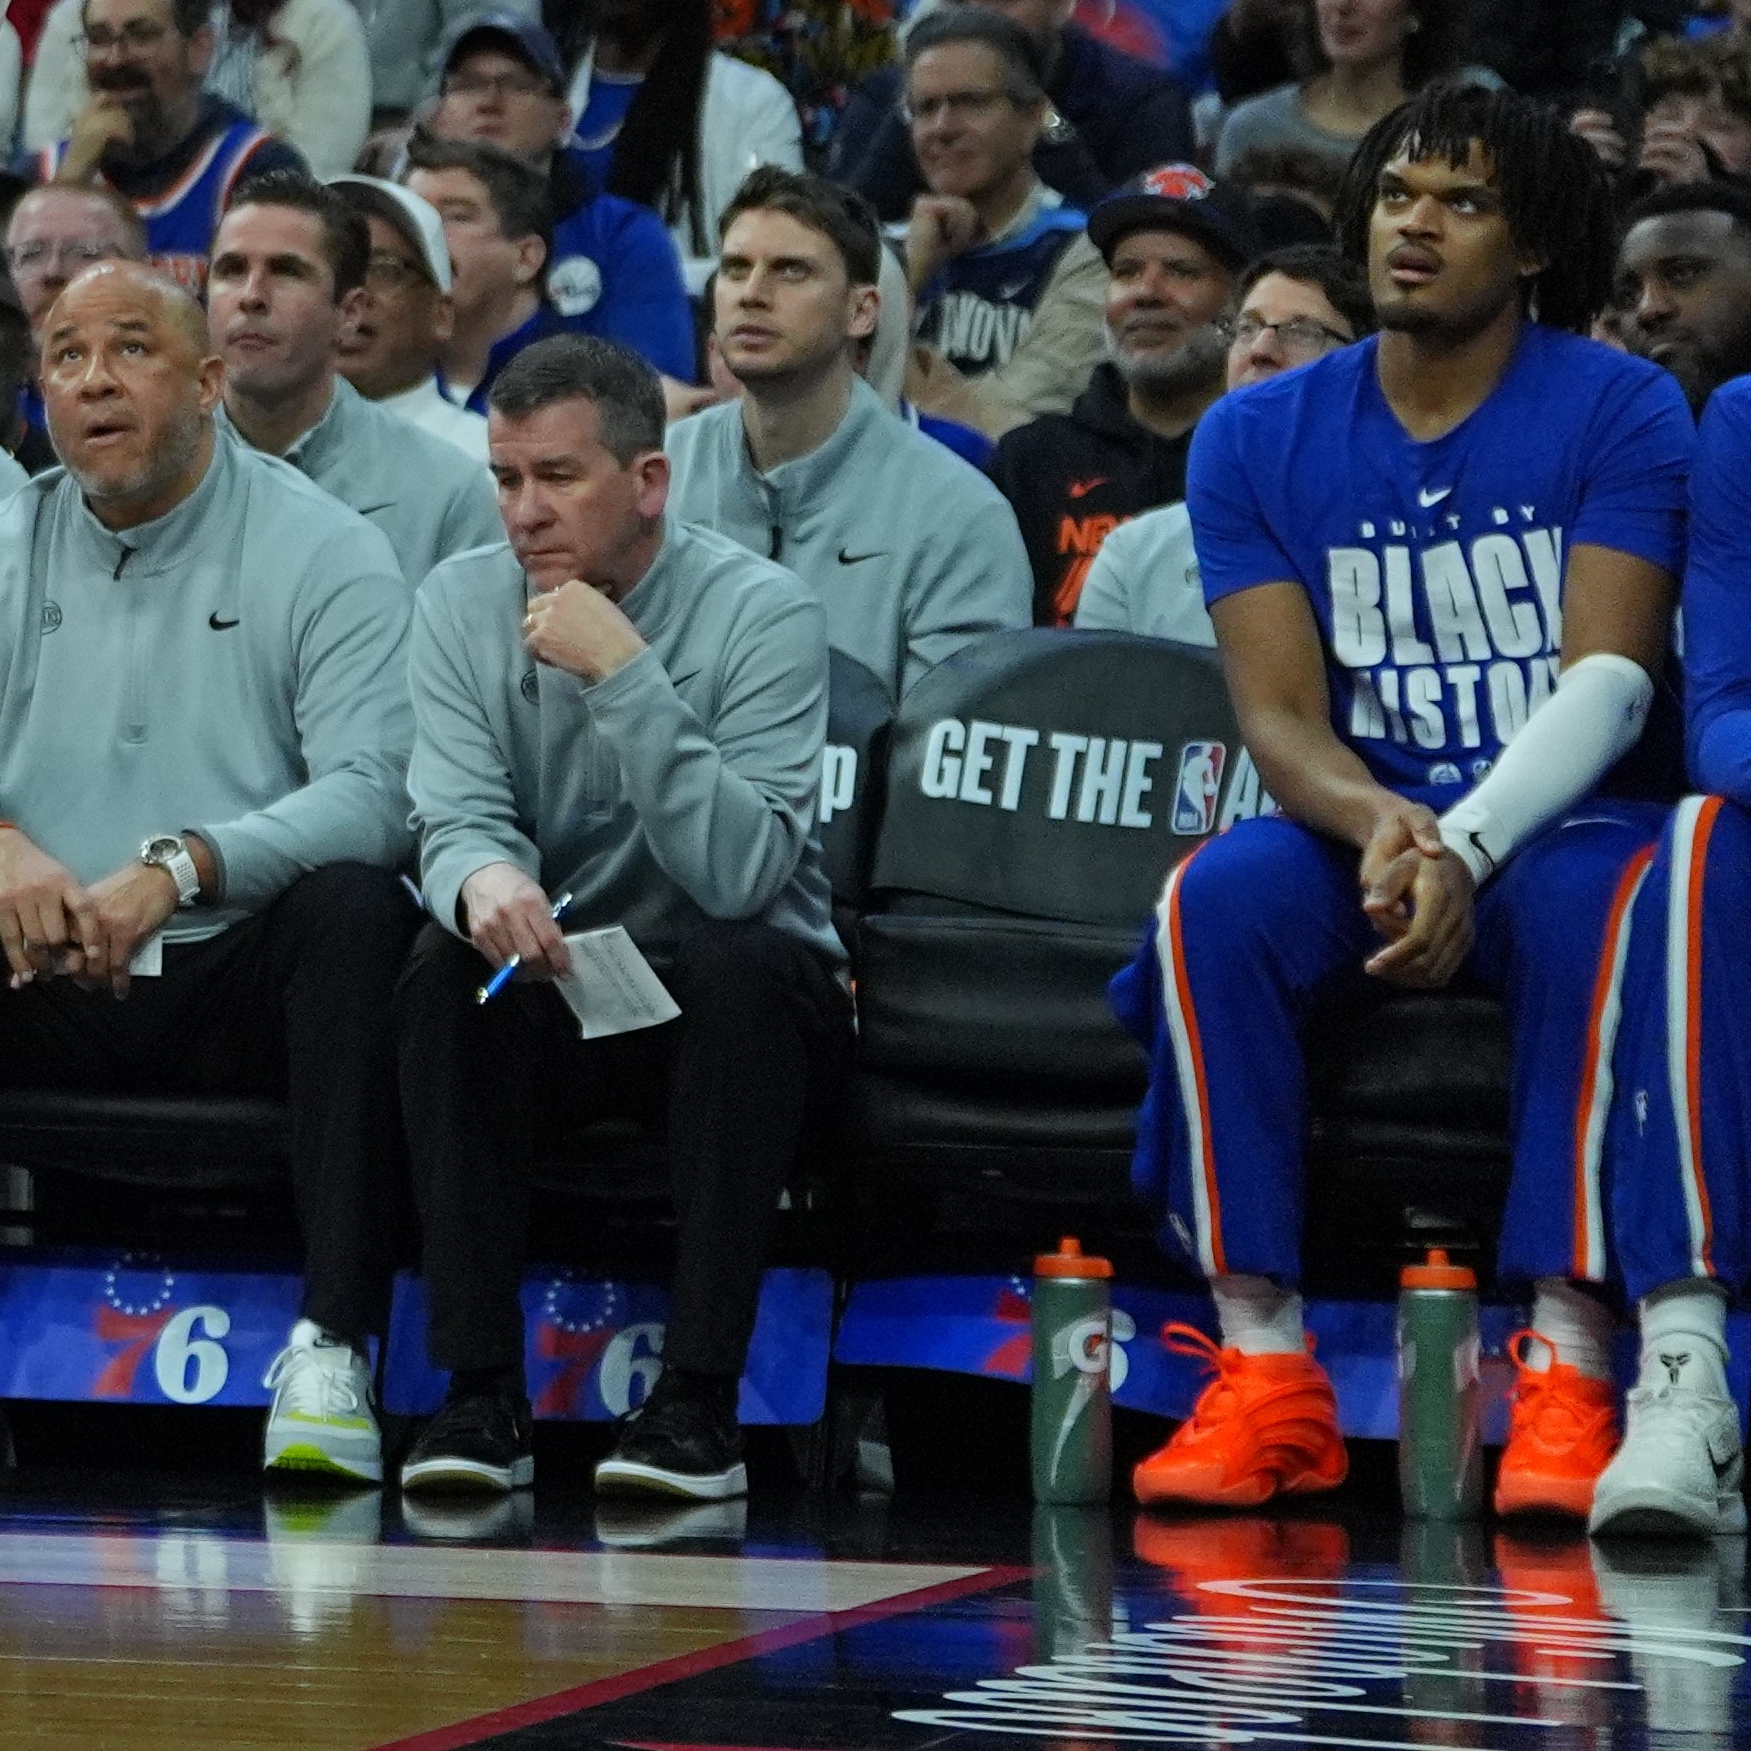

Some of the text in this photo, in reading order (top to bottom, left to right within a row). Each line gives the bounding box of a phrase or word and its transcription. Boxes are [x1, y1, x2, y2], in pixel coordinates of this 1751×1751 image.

[1056, 513, 1136, 555] NE
[1492, 504, 1535, 526] BY
[920, 719, 1040, 812] GET
[1048, 732, 1164, 829] THE
[93, 1303, 231, 1405] 76
[532, 1321, 667, 1422] 76
